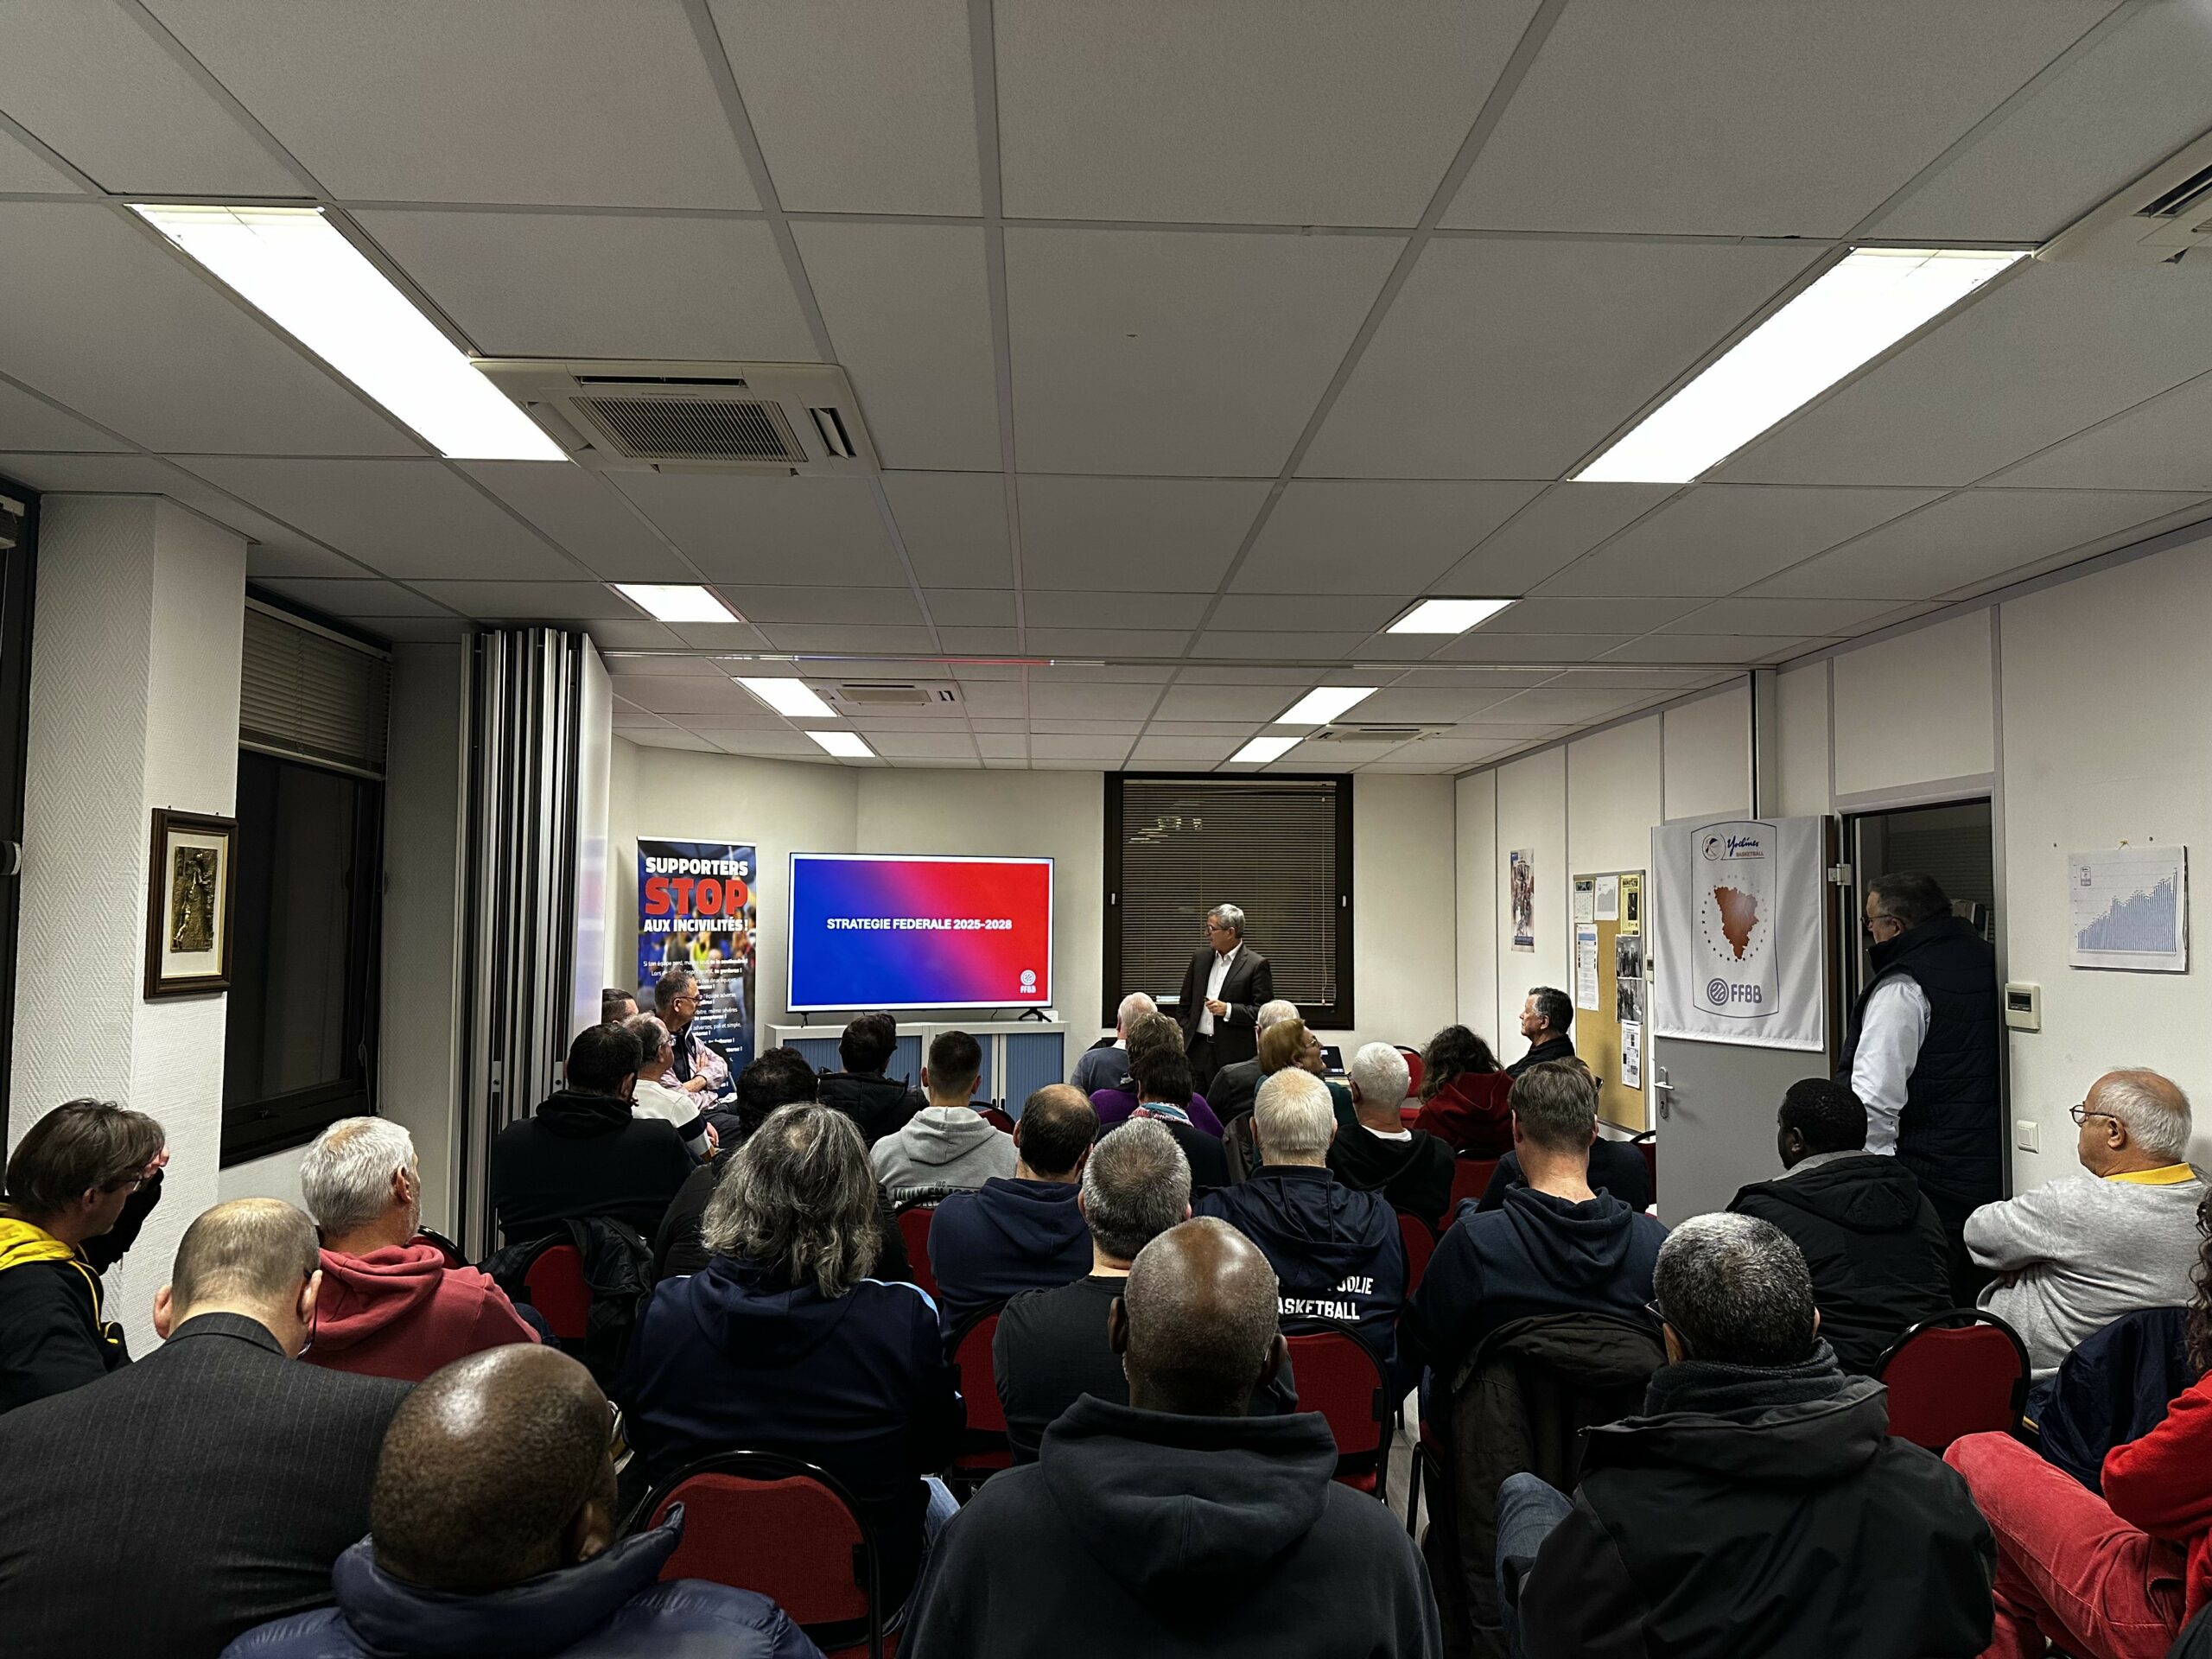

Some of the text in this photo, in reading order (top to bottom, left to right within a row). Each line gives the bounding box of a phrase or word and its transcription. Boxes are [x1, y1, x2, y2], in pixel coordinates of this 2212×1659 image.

[645, 857, 748, 876] SUPPORTERS
[645, 877, 747, 915] STOP
[644, 918, 671, 931] AUX
[827, 918, 1012, 930] STRATEGIE FEDERALE 2025-2028
[1020, 985, 1036, 994] FFBB
[1731, 983, 1763, 1004] FFBB
[1337, 1276, 1374, 1294] JOLIE
[1278, 1296, 1360, 1319] ASKETBALL
